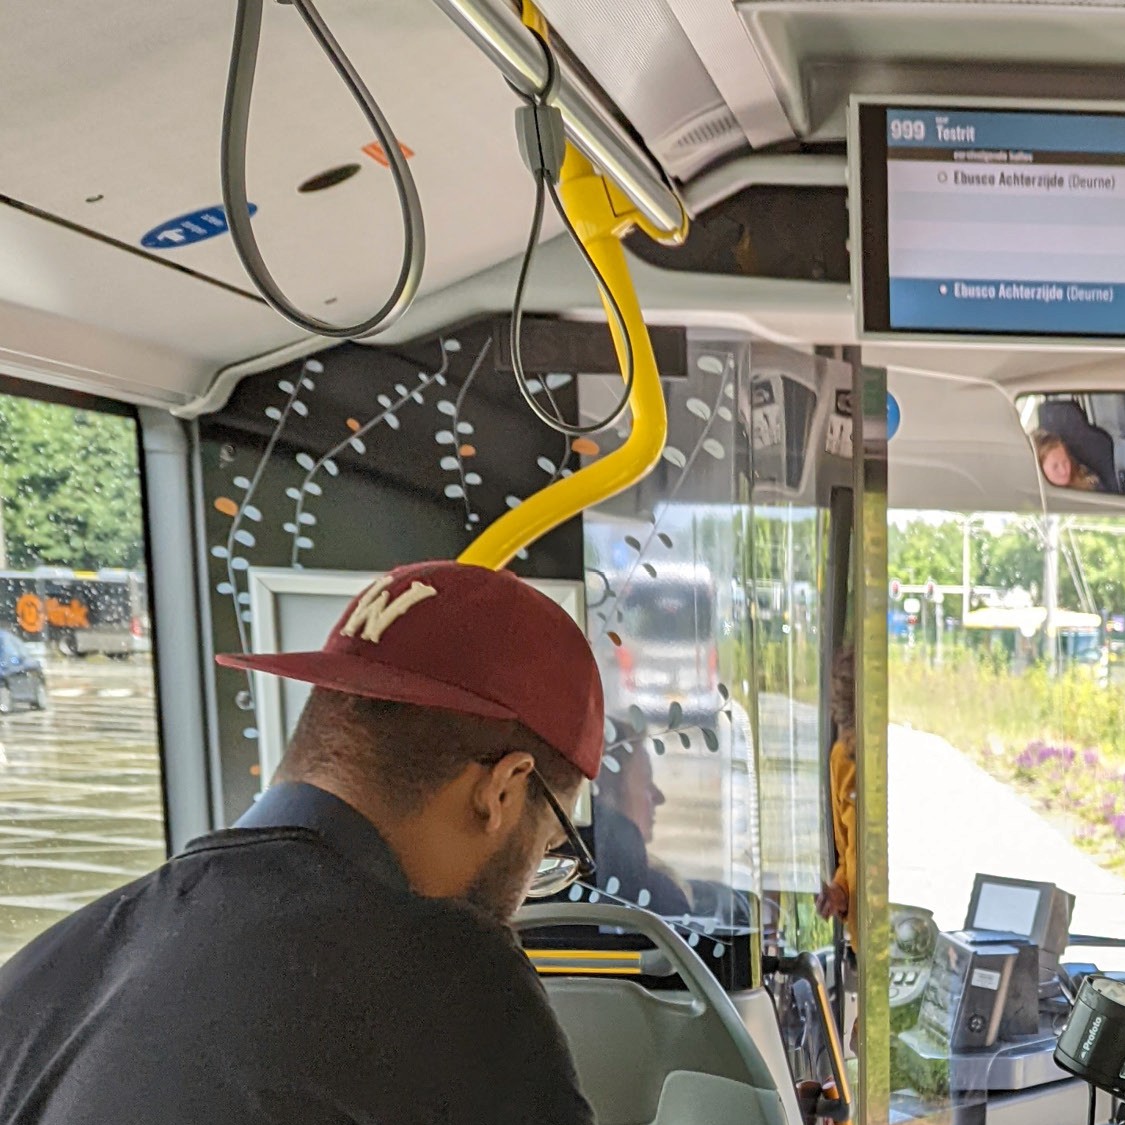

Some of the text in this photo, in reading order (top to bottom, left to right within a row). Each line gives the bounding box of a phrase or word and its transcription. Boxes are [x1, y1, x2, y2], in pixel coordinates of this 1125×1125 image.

[890, 120, 925, 140] 999
[935, 125, 976, 142] Testrit
[953, 170, 1116, 190] Ebusco Achterzijde (Deurne)
[954, 281, 1114, 303] Ebusco Achterzijde (Deurne)
[340, 575, 438, 644] W
[1082, 1016, 1102, 1051] Profoto
